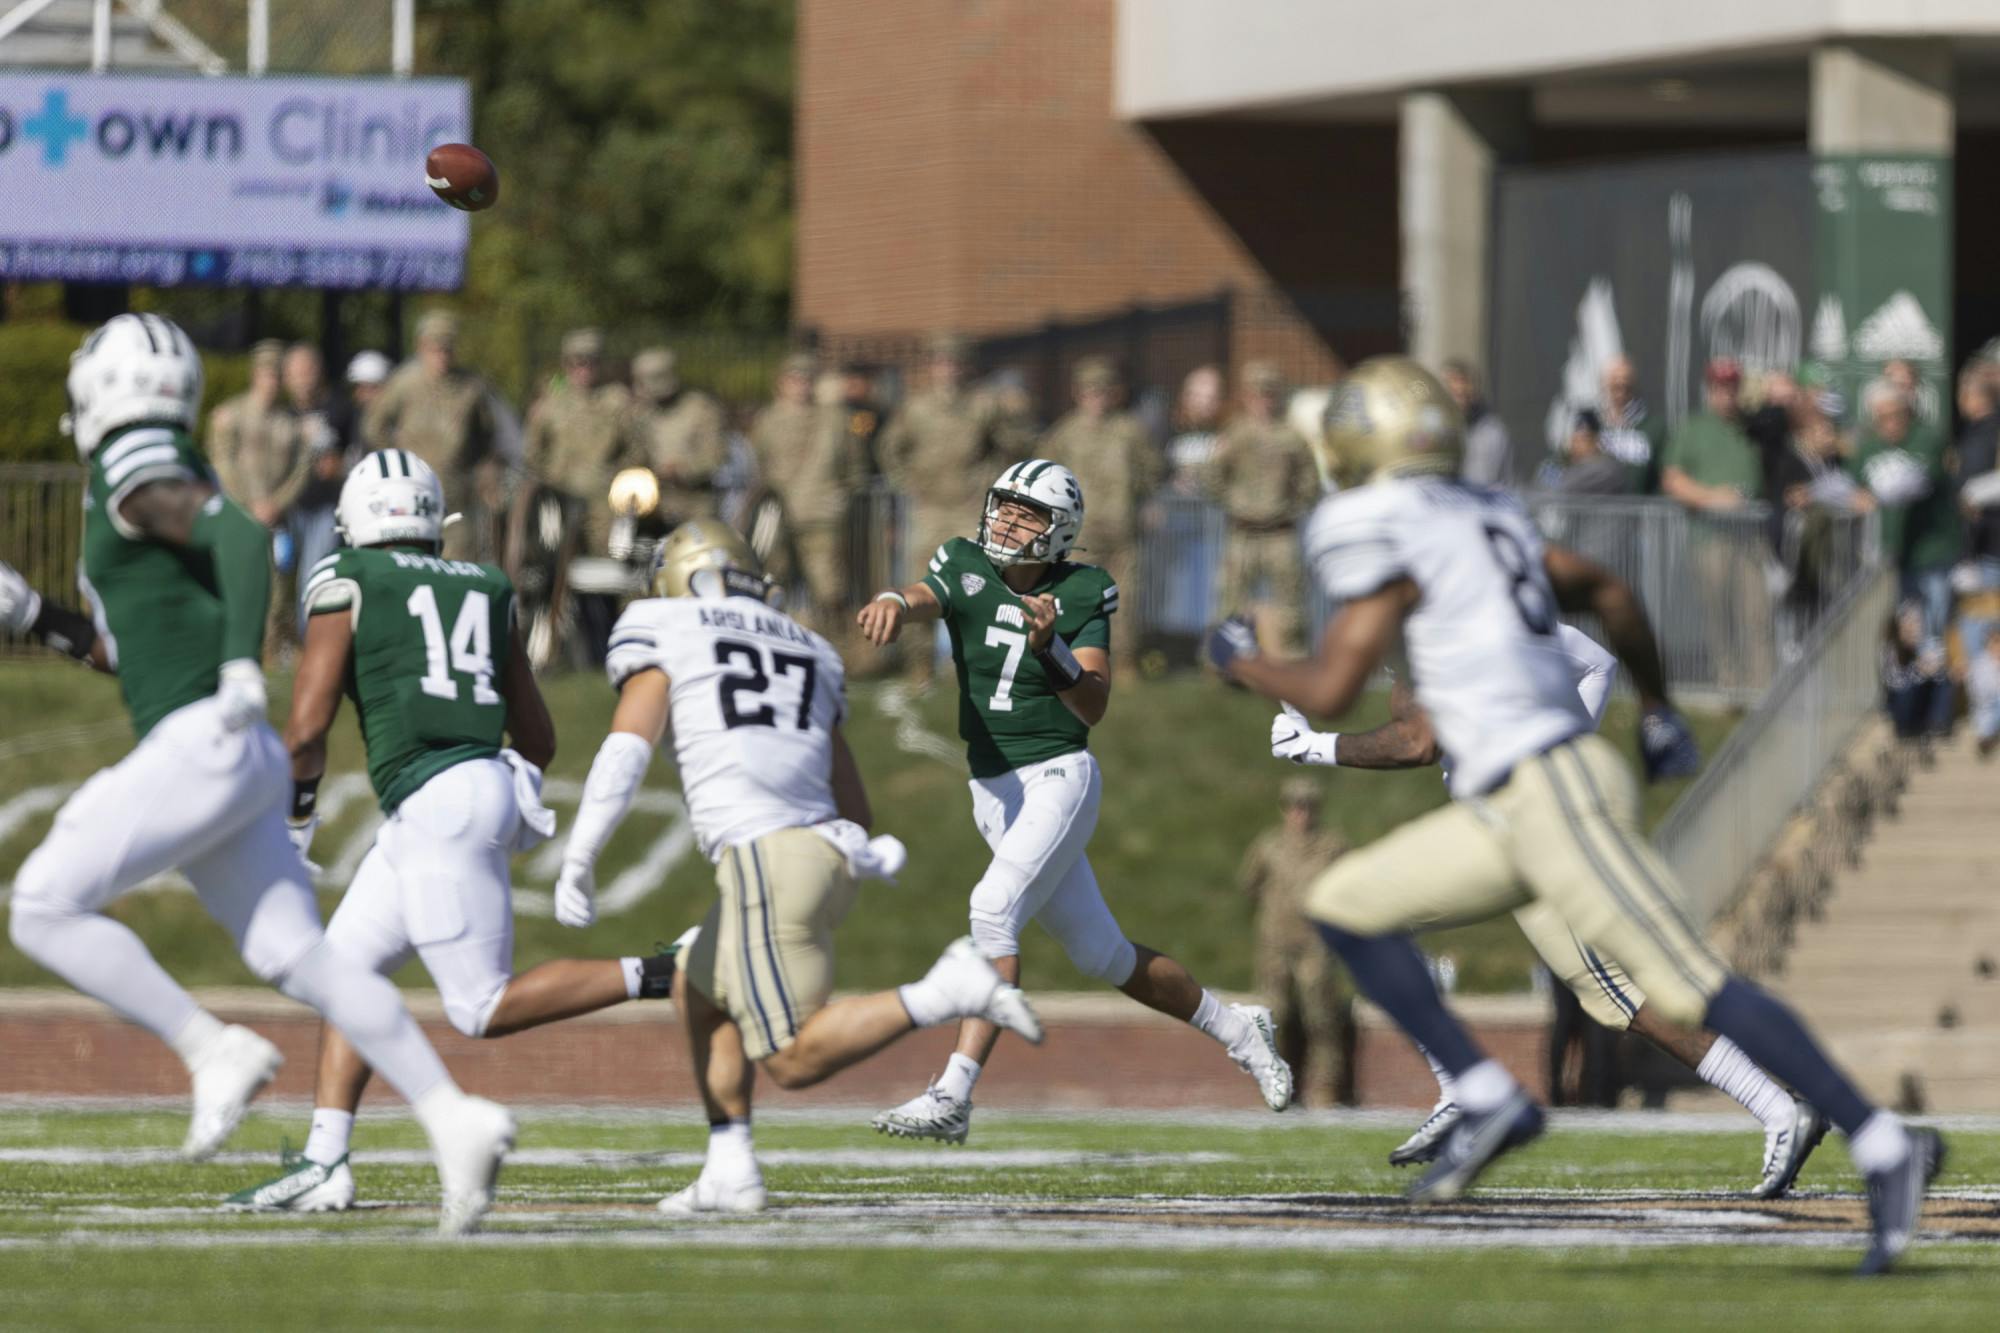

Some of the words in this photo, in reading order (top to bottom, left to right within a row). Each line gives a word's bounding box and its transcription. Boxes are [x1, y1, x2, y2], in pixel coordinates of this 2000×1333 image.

[1483, 523, 1556, 636] 8
[407, 585, 500, 704] 14
[715, 639, 816, 732] 27
[985, 626, 1027, 711] 7
